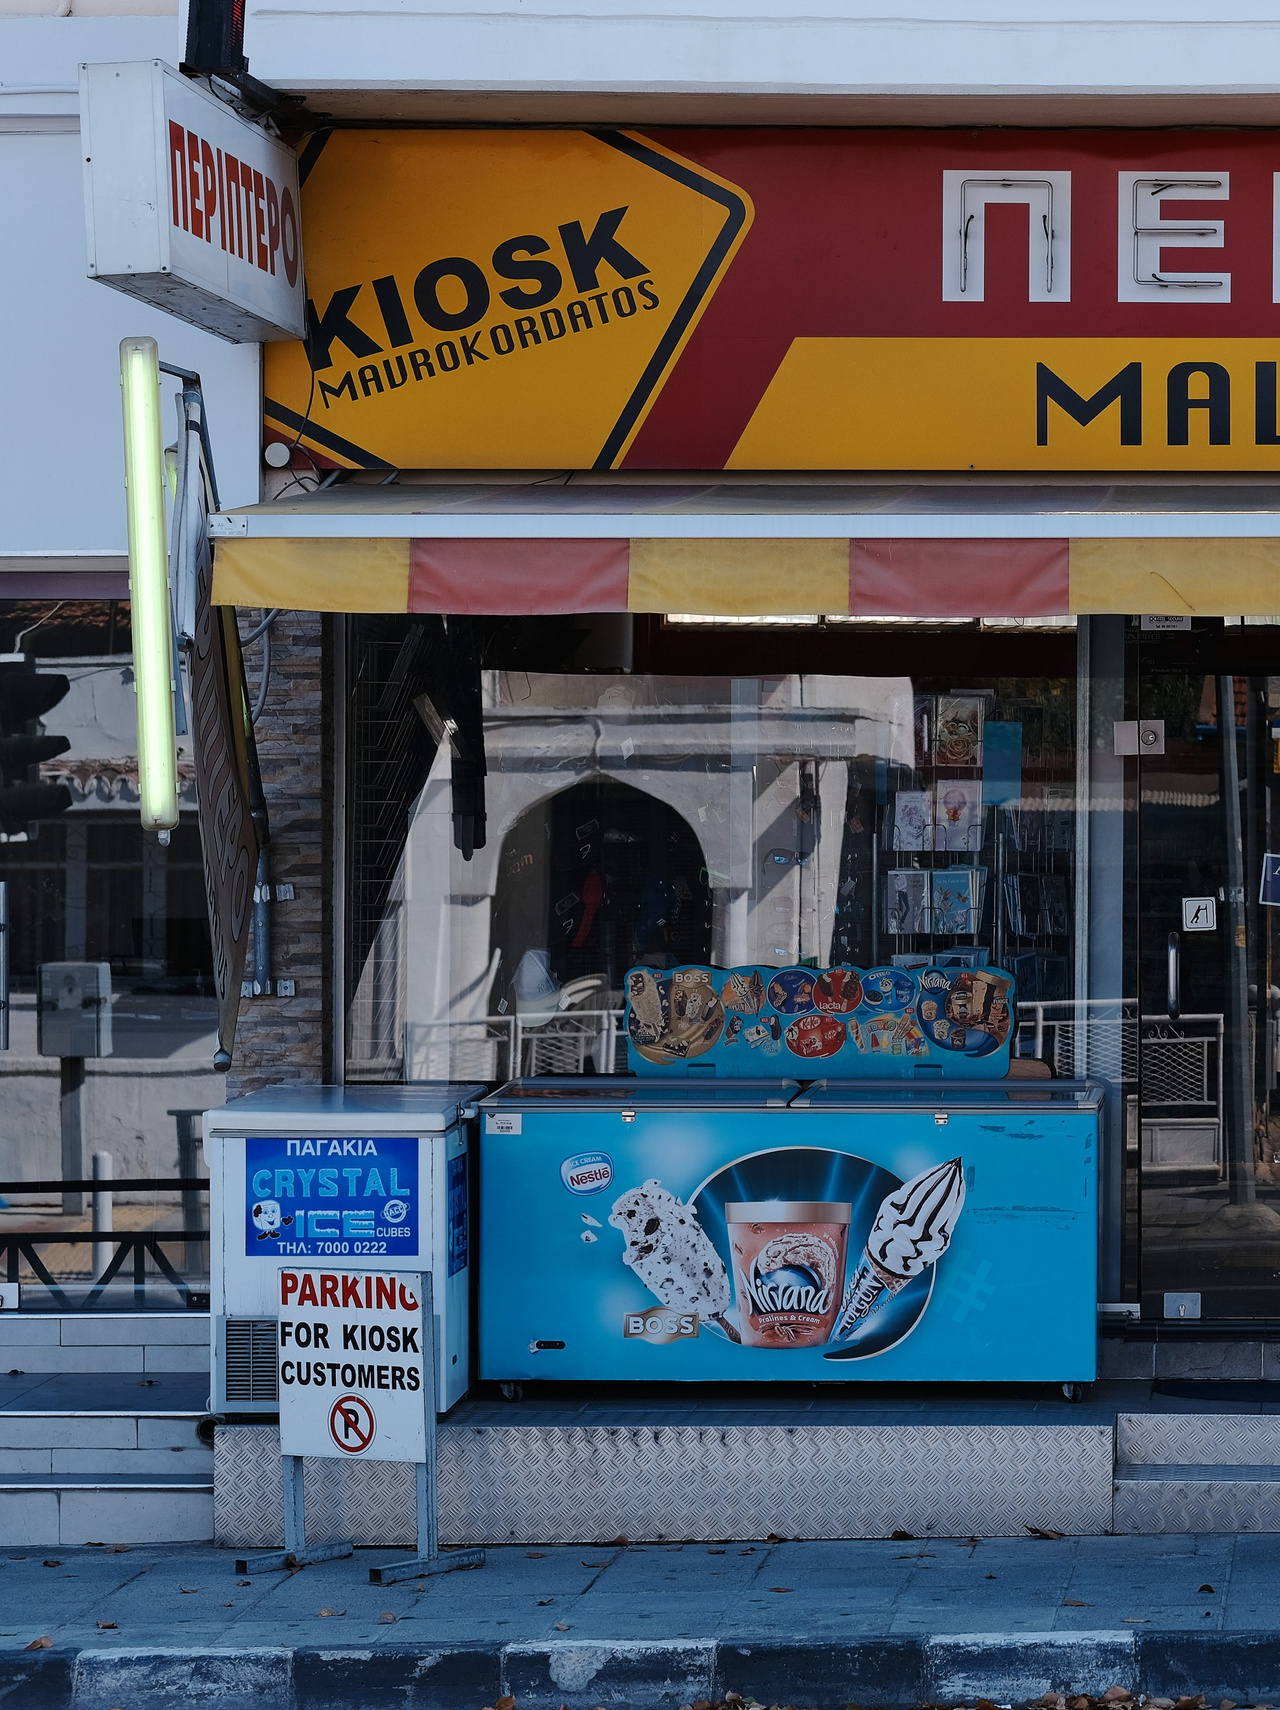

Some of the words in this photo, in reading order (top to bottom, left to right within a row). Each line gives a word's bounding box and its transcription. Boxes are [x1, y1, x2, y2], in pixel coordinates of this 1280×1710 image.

[169, 119, 299, 289] ΠΕΡΙΠΤΕΡΟ
[306, 206, 651, 371] KIOSK
[319, 278, 661, 410] MAVROKORDATOS
[676, 974, 710, 983] BOSS
[917, 969, 952, 992] Nirvana
[819, 1002, 842, 1010] Lacta
[286, 1139, 378, 1156] ΠΑΓΑΚΙΑ
[570, 1159, 580, 1168] ICE
[580, 1155, 603, 1165] CREAM
[252, 1167, 411, 1198] CRYSTAL
[383, 1203, 408, 1219] HACCP
[295, 1210, 376, 1238] ICE
[376, 1227, 411, 1238] CUBES
[277, 1242, 312, 1254] ΤΗΛ:
[316, 1241, 350, 1254] 7000
[354, 1242, 387, 1254] 0222
[281, 1272, 419, 1312] PARKING
[739, 1257, 831, 1316] Nirvana
[629, 1315, 695, 1335] BOSS
[758, 1314, 788, 1324] Pralines
[798, 1314, 821, 1324] Cream
[280, 1320, 330, 1349] FOR
[343, 1323, 420, 1353] KIOSK
[280, 1360, 421, 1392] CUSTOMERS
